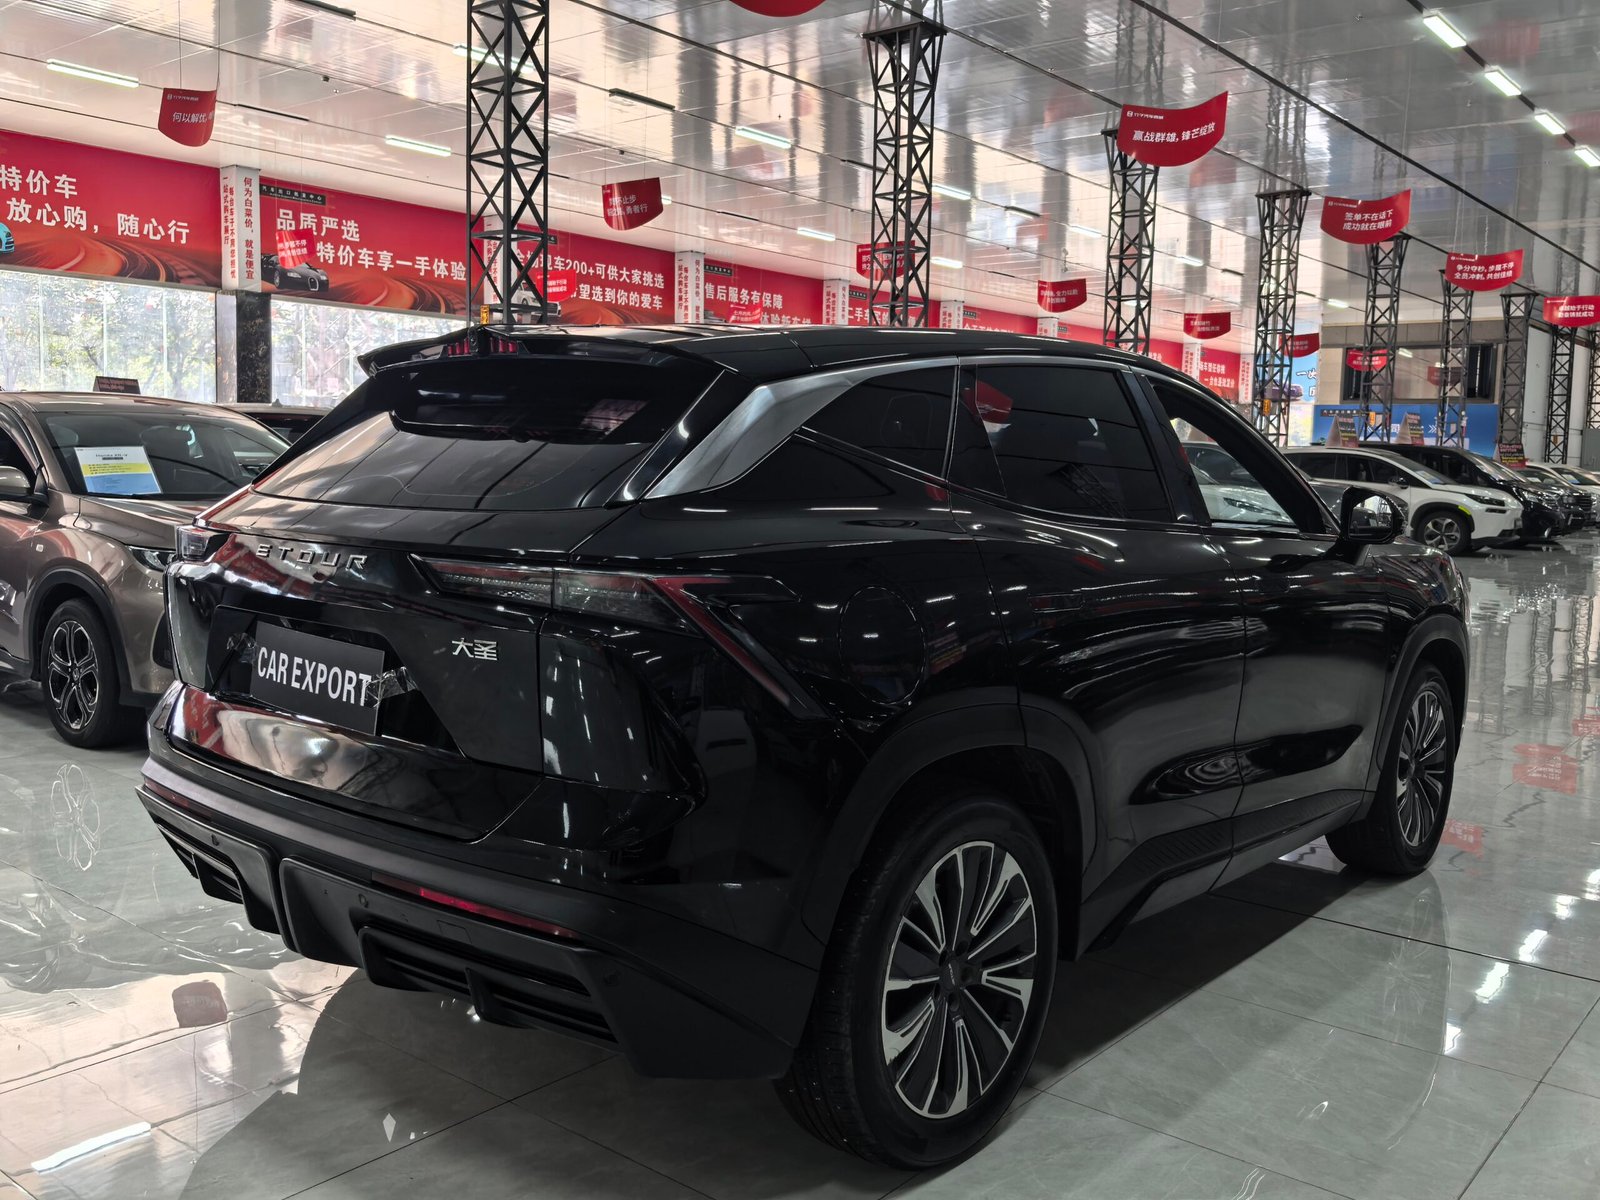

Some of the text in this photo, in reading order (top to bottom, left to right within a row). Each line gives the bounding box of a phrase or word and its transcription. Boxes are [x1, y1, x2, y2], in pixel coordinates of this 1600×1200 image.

[0, 164, 78, 199] 特价车
[570, 282, 664, 310] 望选到你的爱车
[452, 637, 498, 661] 大圣
[257, 646, 372, 707] CAR EXPORT
